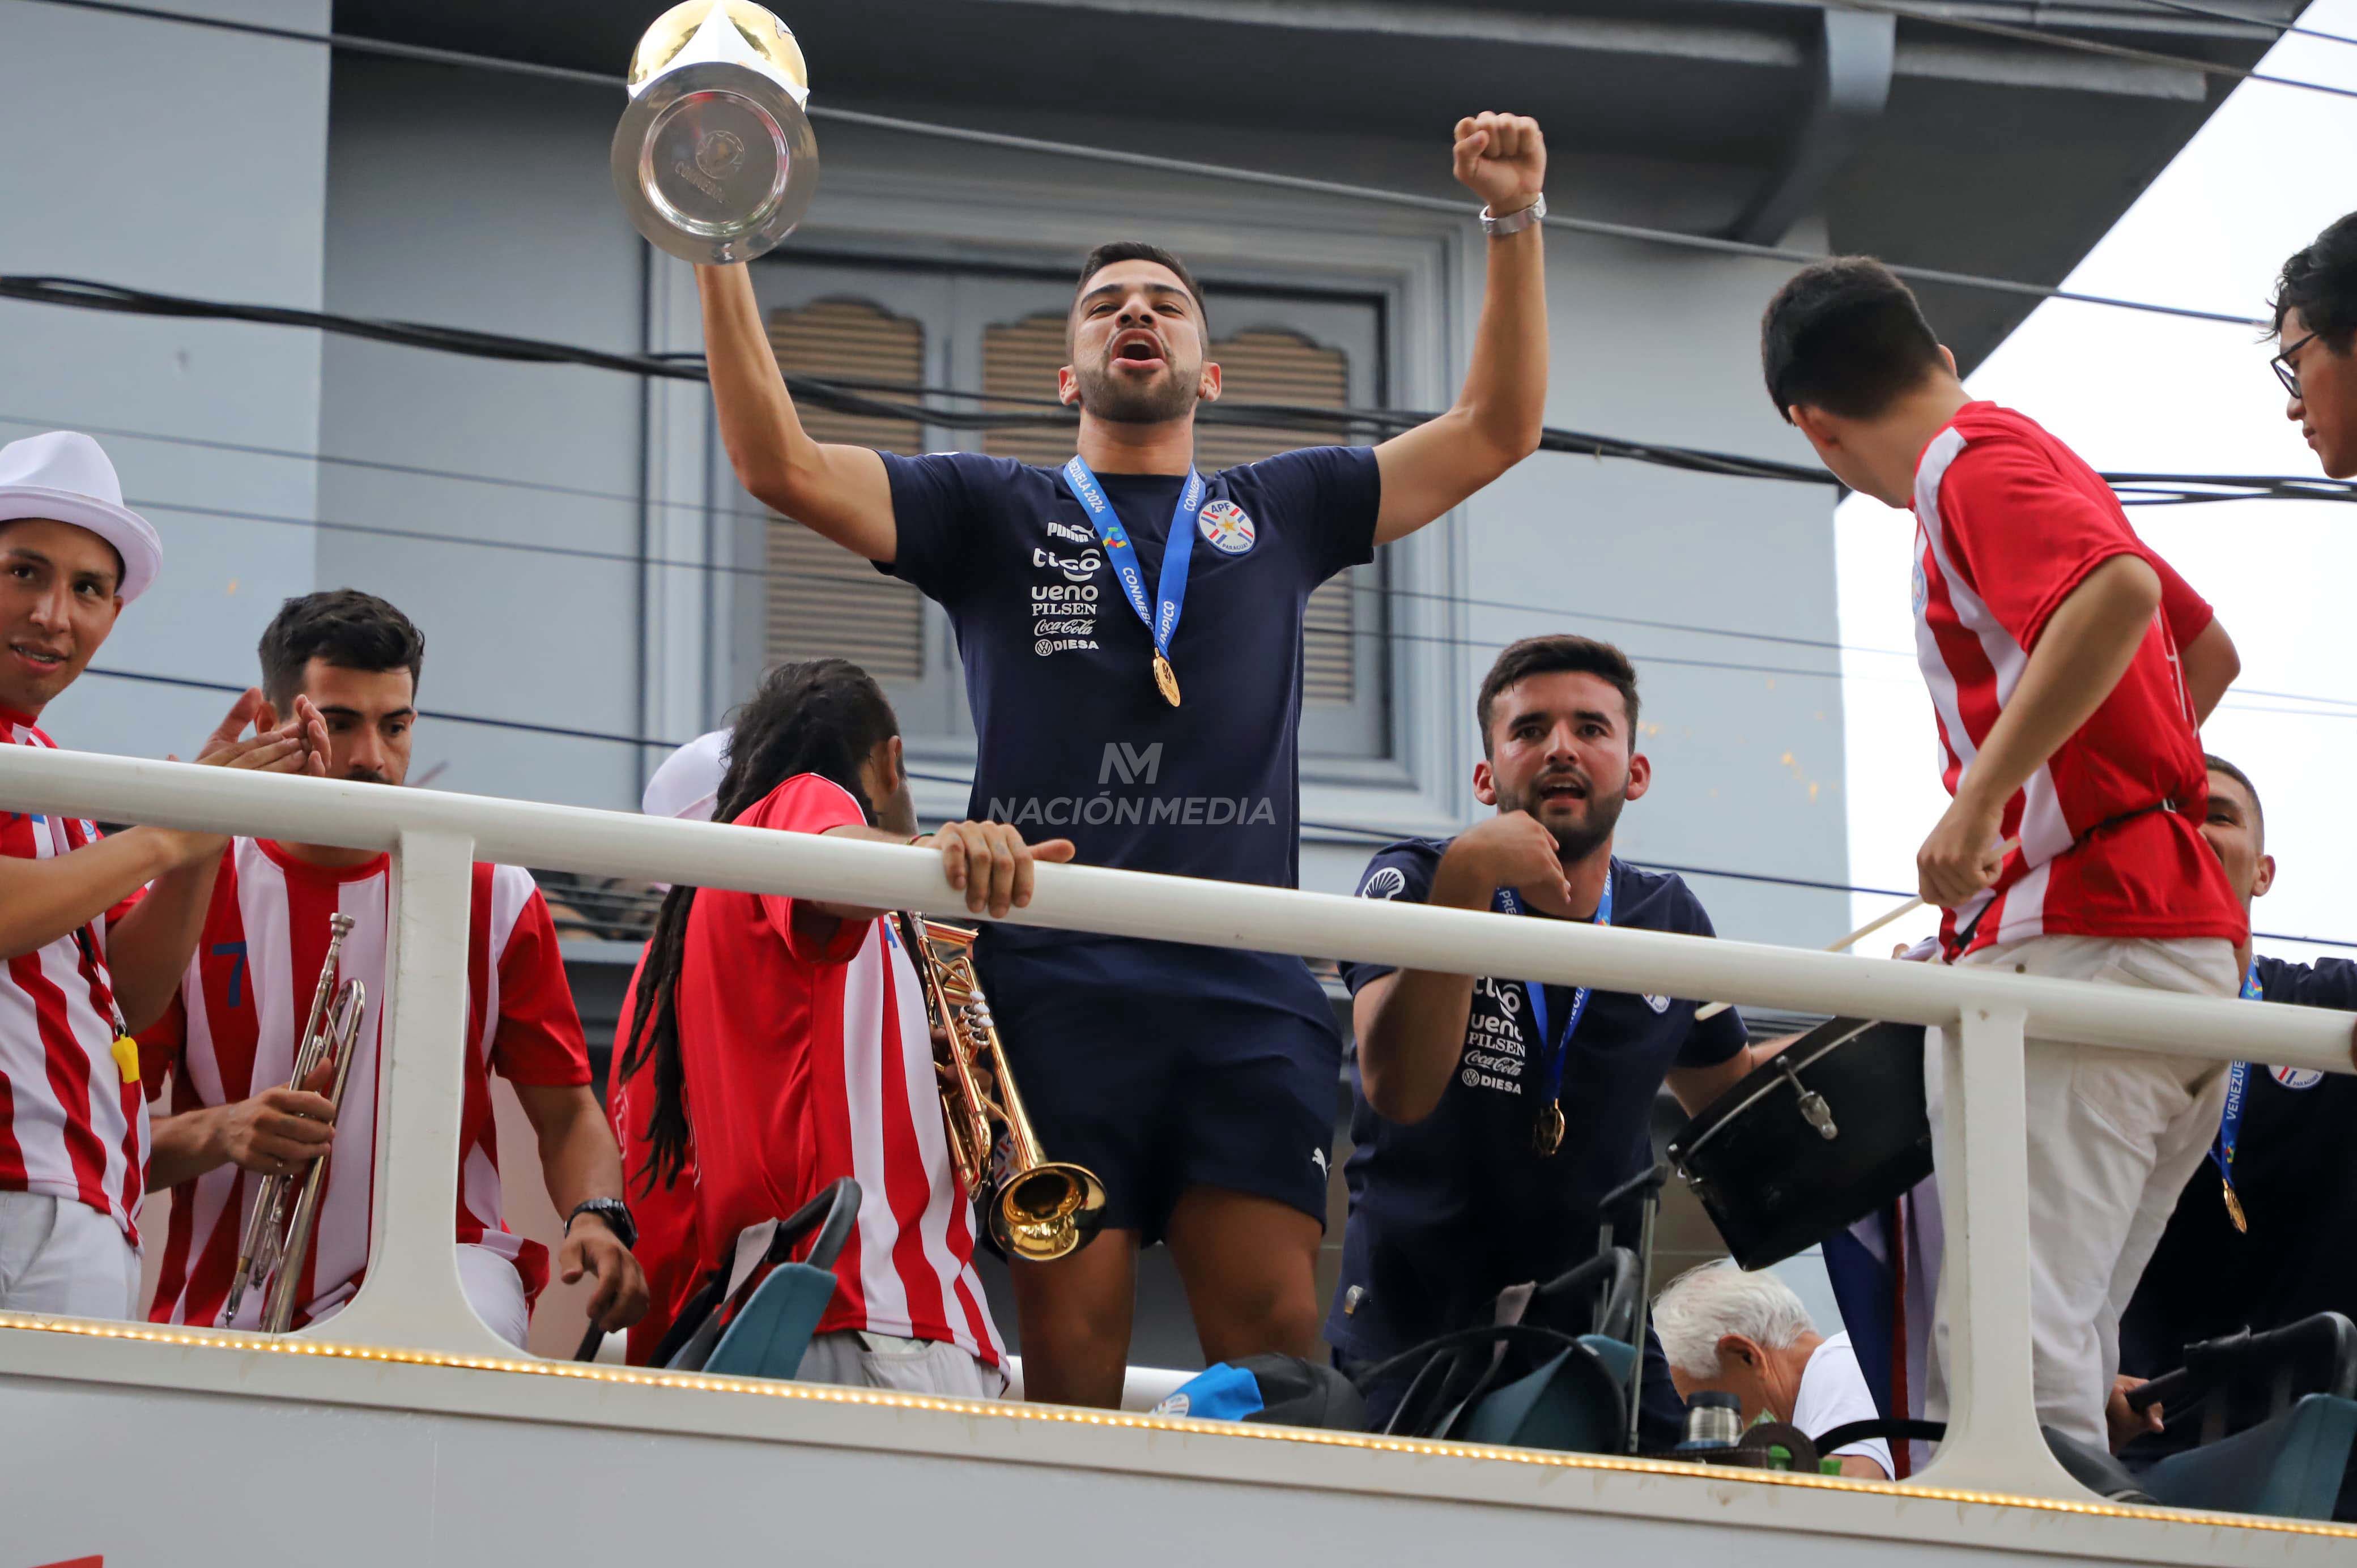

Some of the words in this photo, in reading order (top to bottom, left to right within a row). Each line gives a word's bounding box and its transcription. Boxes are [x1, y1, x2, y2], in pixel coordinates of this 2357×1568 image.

[1083, 489, 1106, 513] 2024
[1211, 502, 1231, 513] APF
[1033, 547, 1101, 578] tigo
[1031, 585, 1099, 601] ueno
[1031, 603, 1097, 616] PILSEN
[1053, 639, 1099, 651] DIESA
[212, 941, 247, 1008] 7
[1469, 1032, 1526, 1057] PILSEN
[1480, 1075, 1521, 1094] DIESA
